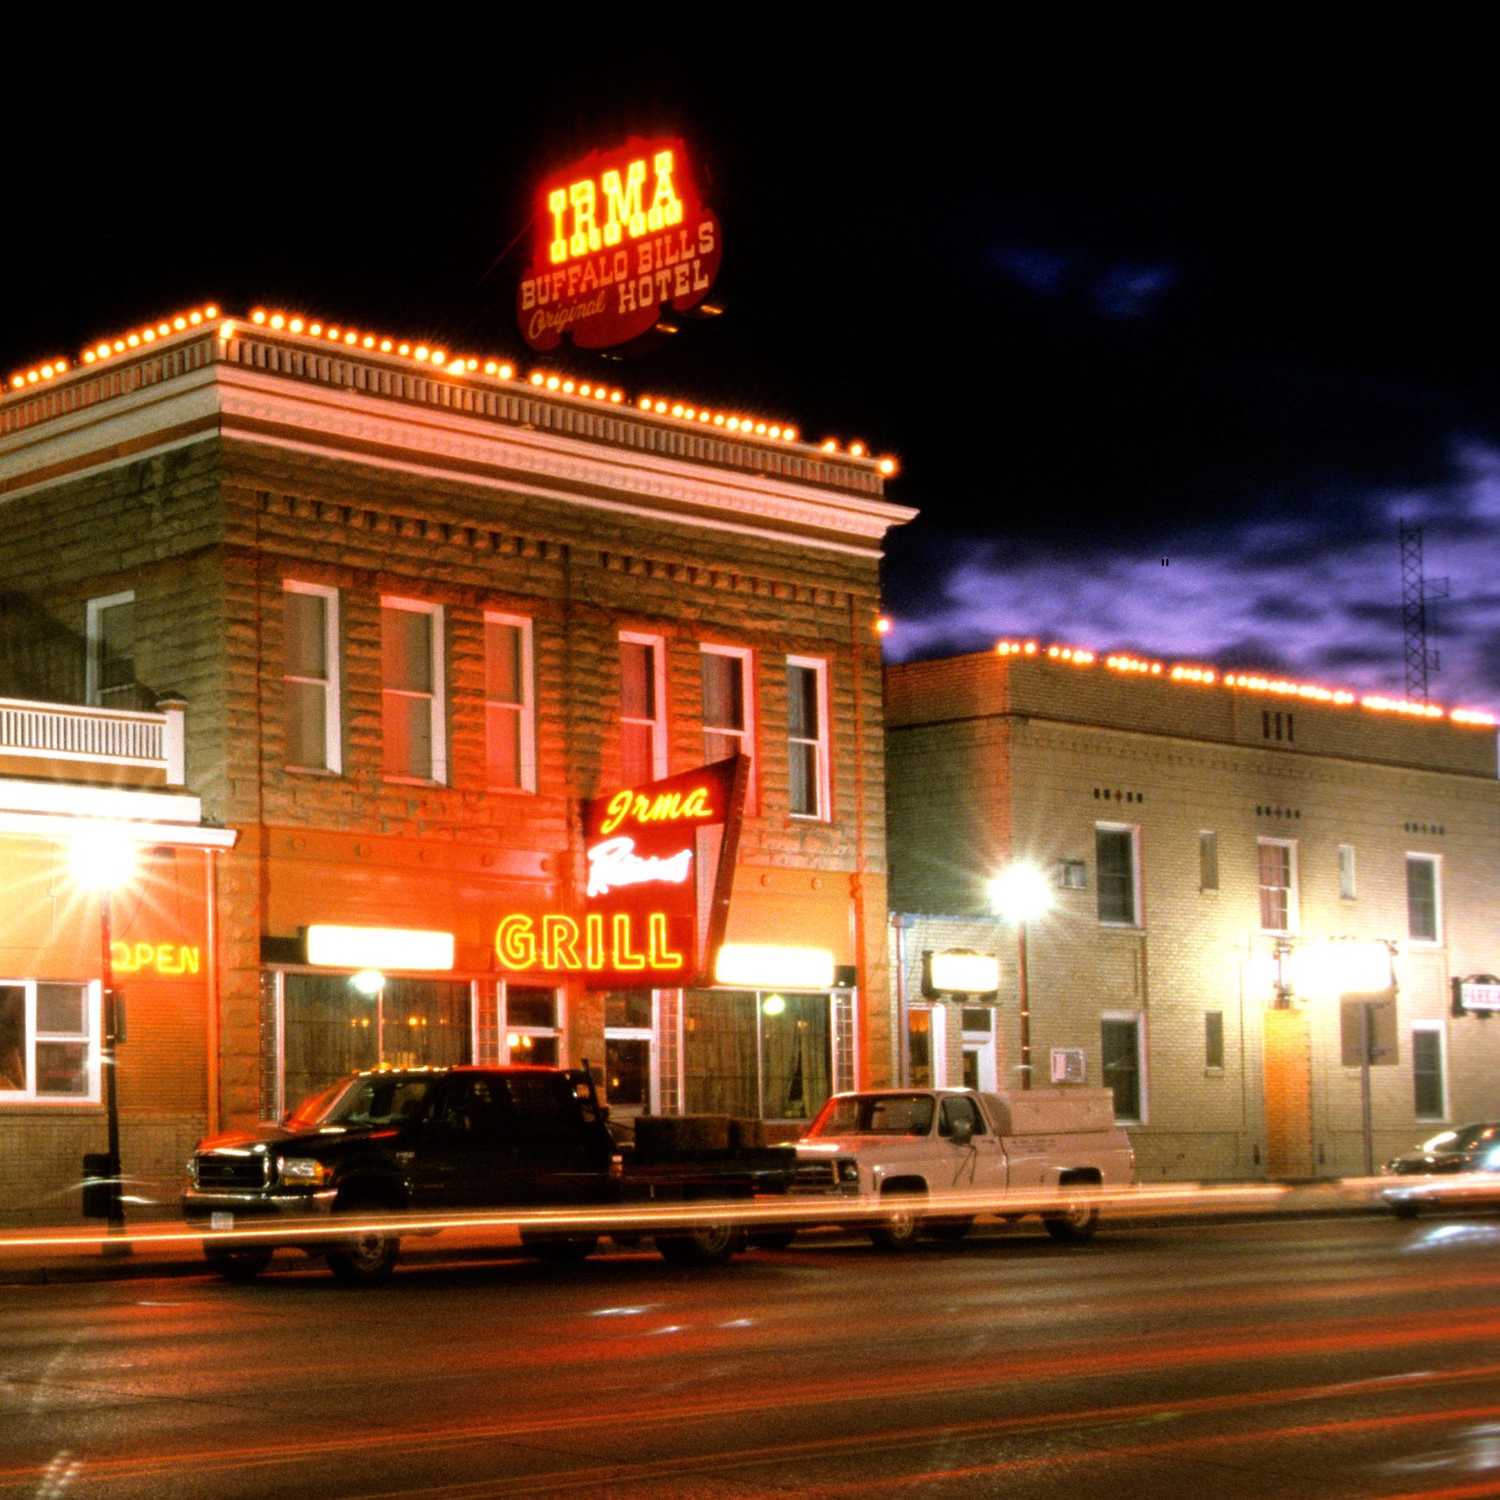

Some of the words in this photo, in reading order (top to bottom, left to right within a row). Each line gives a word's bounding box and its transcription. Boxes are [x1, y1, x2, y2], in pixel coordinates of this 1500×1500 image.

[549, 150, 683, 264] IRMA
[521, 250, 628, 310] BUFFALO
[637, 221, 715, 275] BILLS
[529, 290, 607, 340] Original
[618, 259, 709, 314] HOTEL
[601, 788, 713, 834] Irma
[110, 941, 199, 974] OPEN
[496, 914, 683, 969] GRILL
